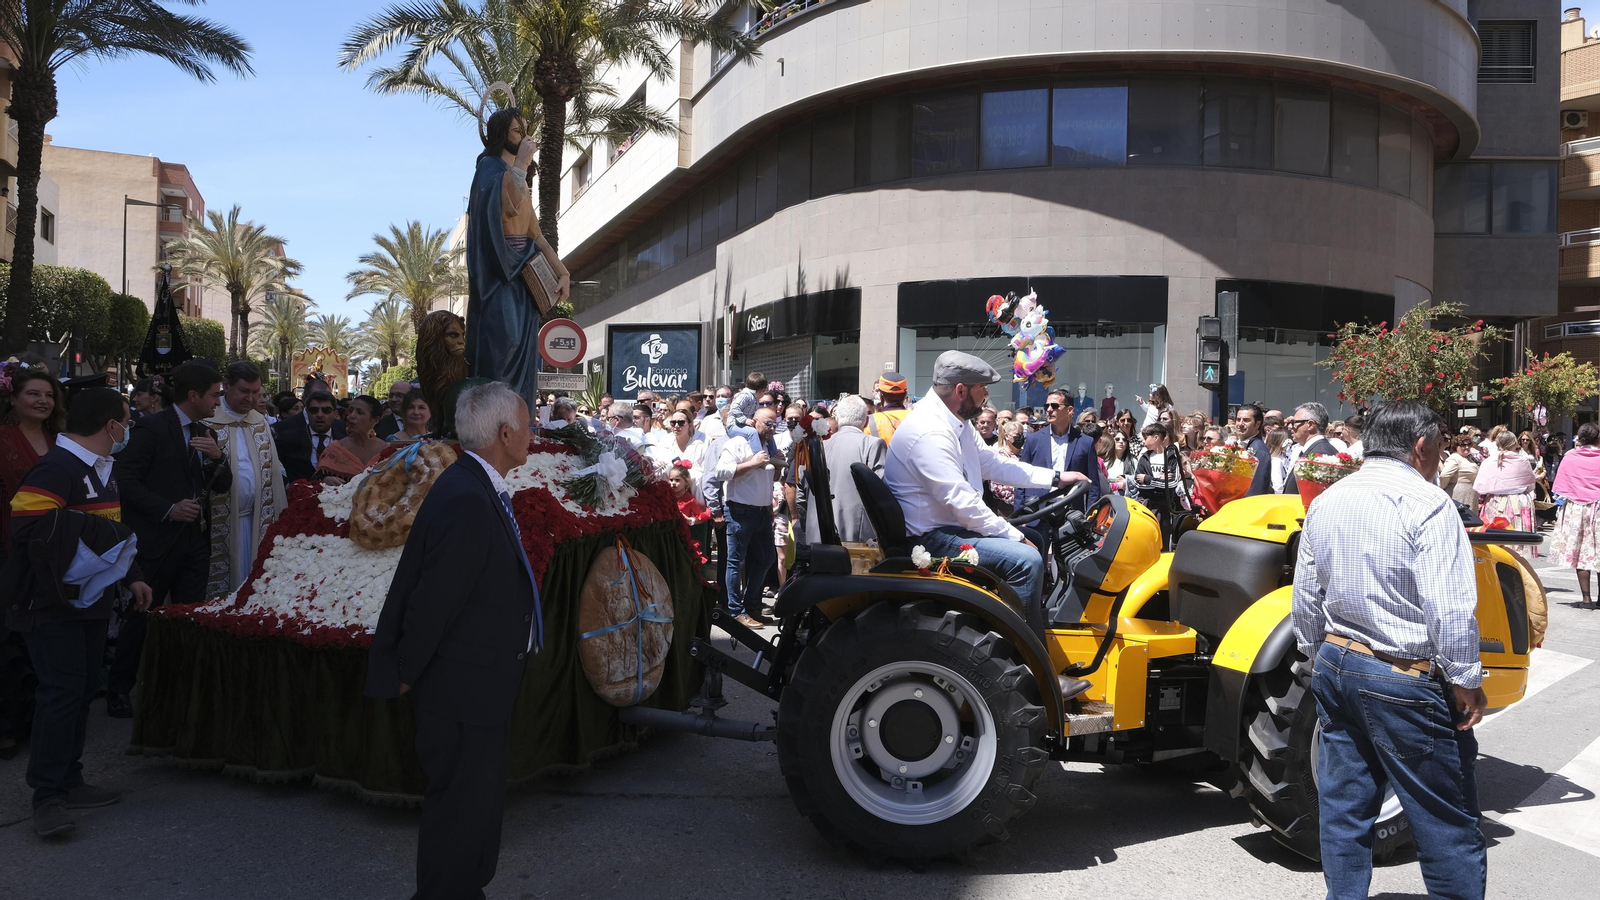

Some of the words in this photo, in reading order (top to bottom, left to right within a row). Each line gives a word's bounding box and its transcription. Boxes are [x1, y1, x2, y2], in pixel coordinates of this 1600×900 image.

[622, 365, 688, 392] Bulevar
[652, 366, 688, 374] Farmacia
[1151, 465, 1165, 473] ANS
[83, 474, 98, 499] 1
[970, 752, 1015, 822] TM700
